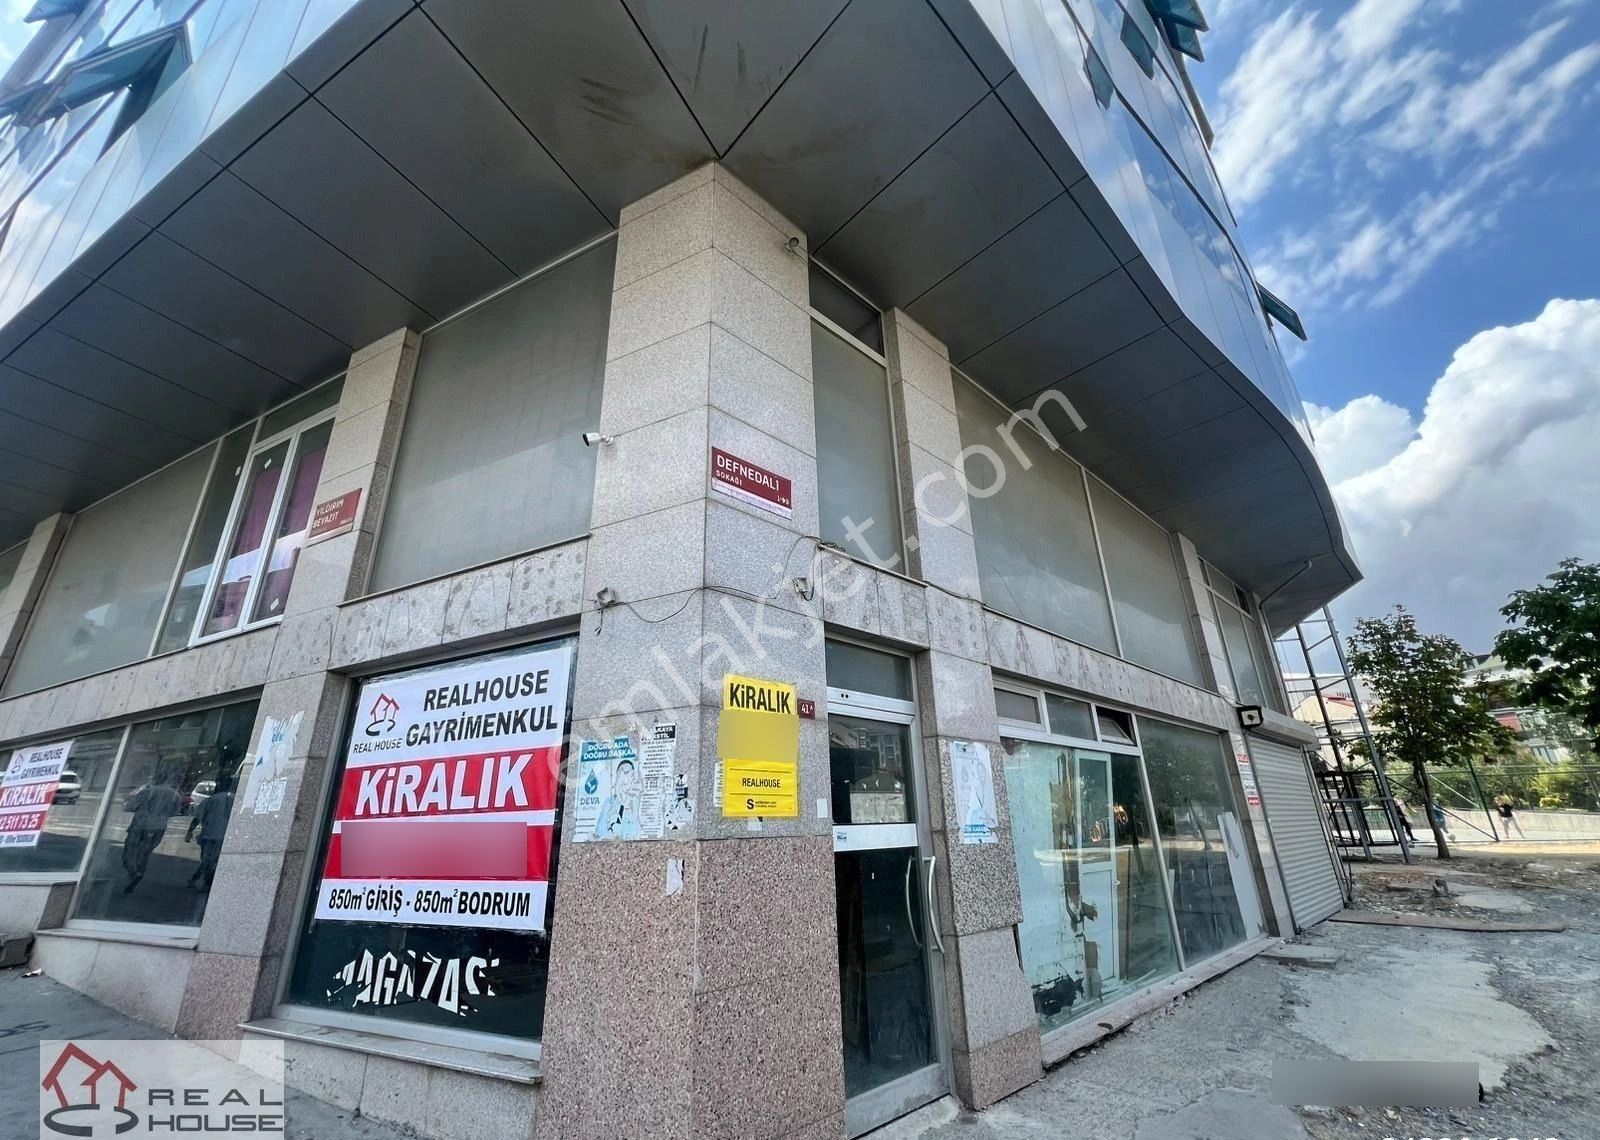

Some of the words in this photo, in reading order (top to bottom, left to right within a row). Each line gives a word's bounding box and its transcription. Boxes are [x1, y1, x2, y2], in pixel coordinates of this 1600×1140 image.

[716, 454, 780, 491] DEFNEDALI
[423, 669, 550, 712] REALHOUSE
[405, 705, 558, 747] GAYRİMENKUL
[353, 743, 373, 754] REAL
[374, 738, 403, 752] HOUSE
[742, 777, 781, 788] REALHOUSE
[580, 797, 600, 805] DEVA
